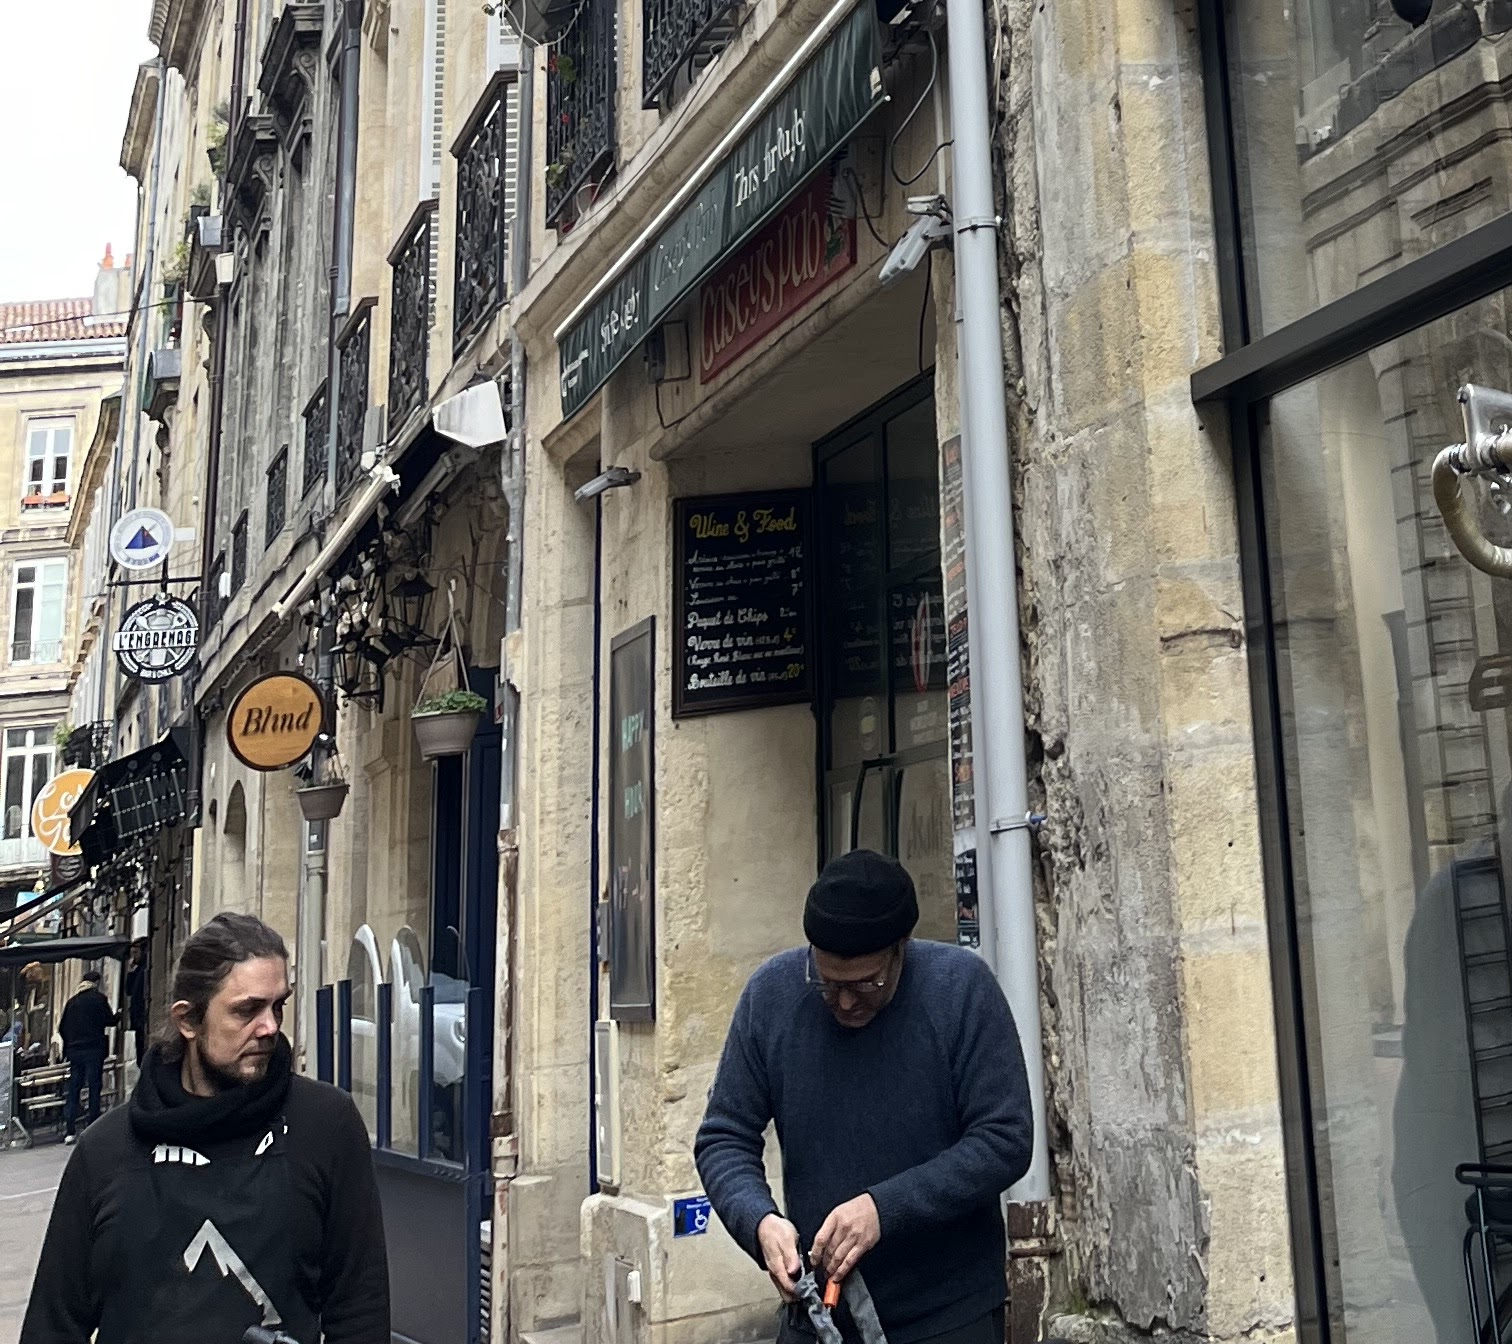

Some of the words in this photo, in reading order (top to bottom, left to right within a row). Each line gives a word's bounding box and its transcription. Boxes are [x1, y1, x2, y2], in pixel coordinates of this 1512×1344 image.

[689, 512, 730, 538] Wine
[734, 510, 750, 543] &
[753, 506, 797, 534] Food
[239, 702, 315, 738] Blind
